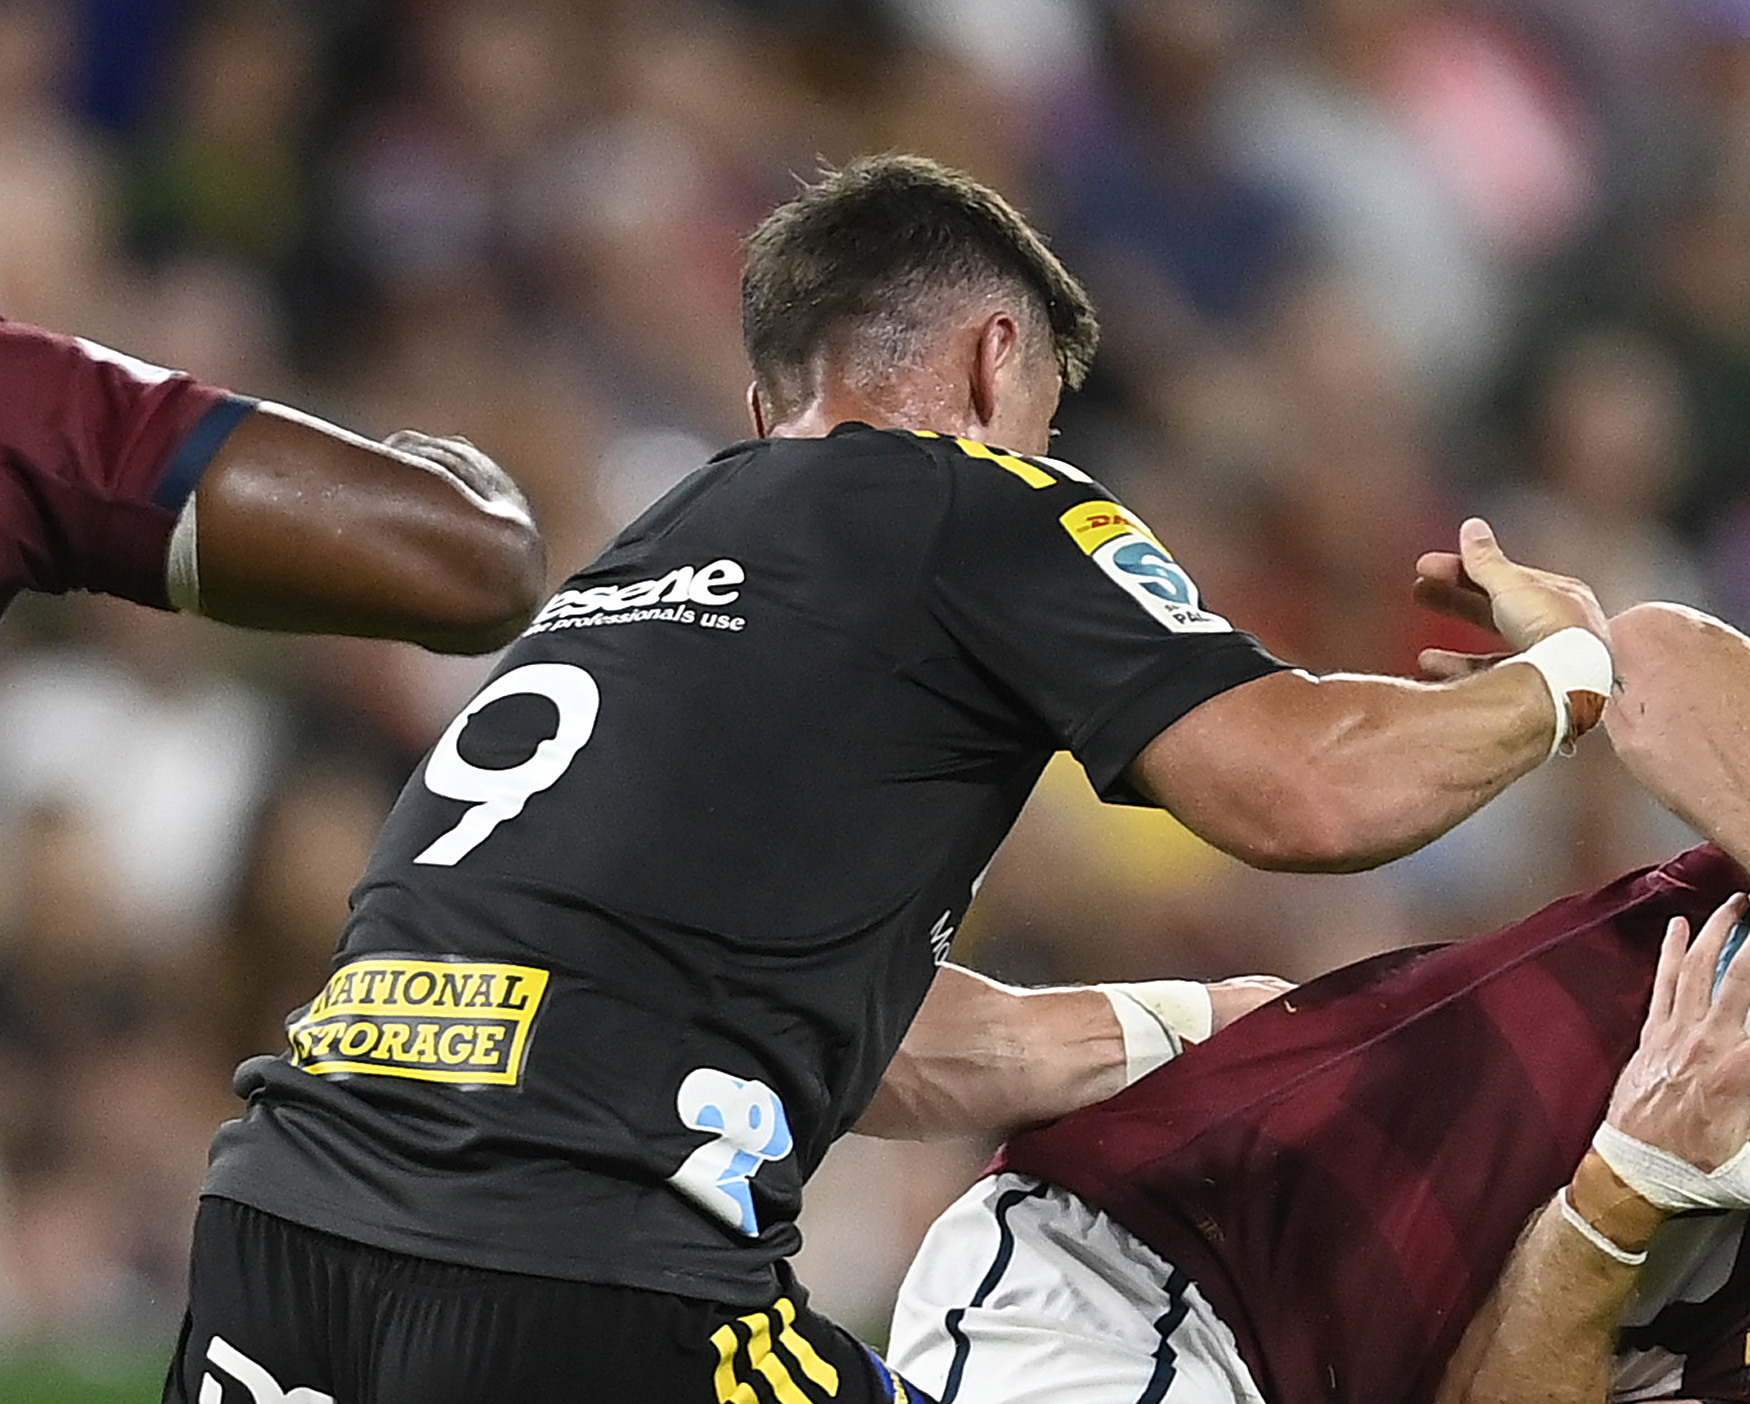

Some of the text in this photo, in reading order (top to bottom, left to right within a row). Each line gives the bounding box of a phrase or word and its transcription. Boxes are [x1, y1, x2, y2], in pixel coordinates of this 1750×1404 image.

[534, 559, 745, 624] esene
[549, 604, 695, 632] professionals
[700, 613, 745, 632] use
[413, 663, 600, 867] 9
[312, 970, 529, 1015] NATIONAL
[294, 1022, 505, 1066] STORAGE
